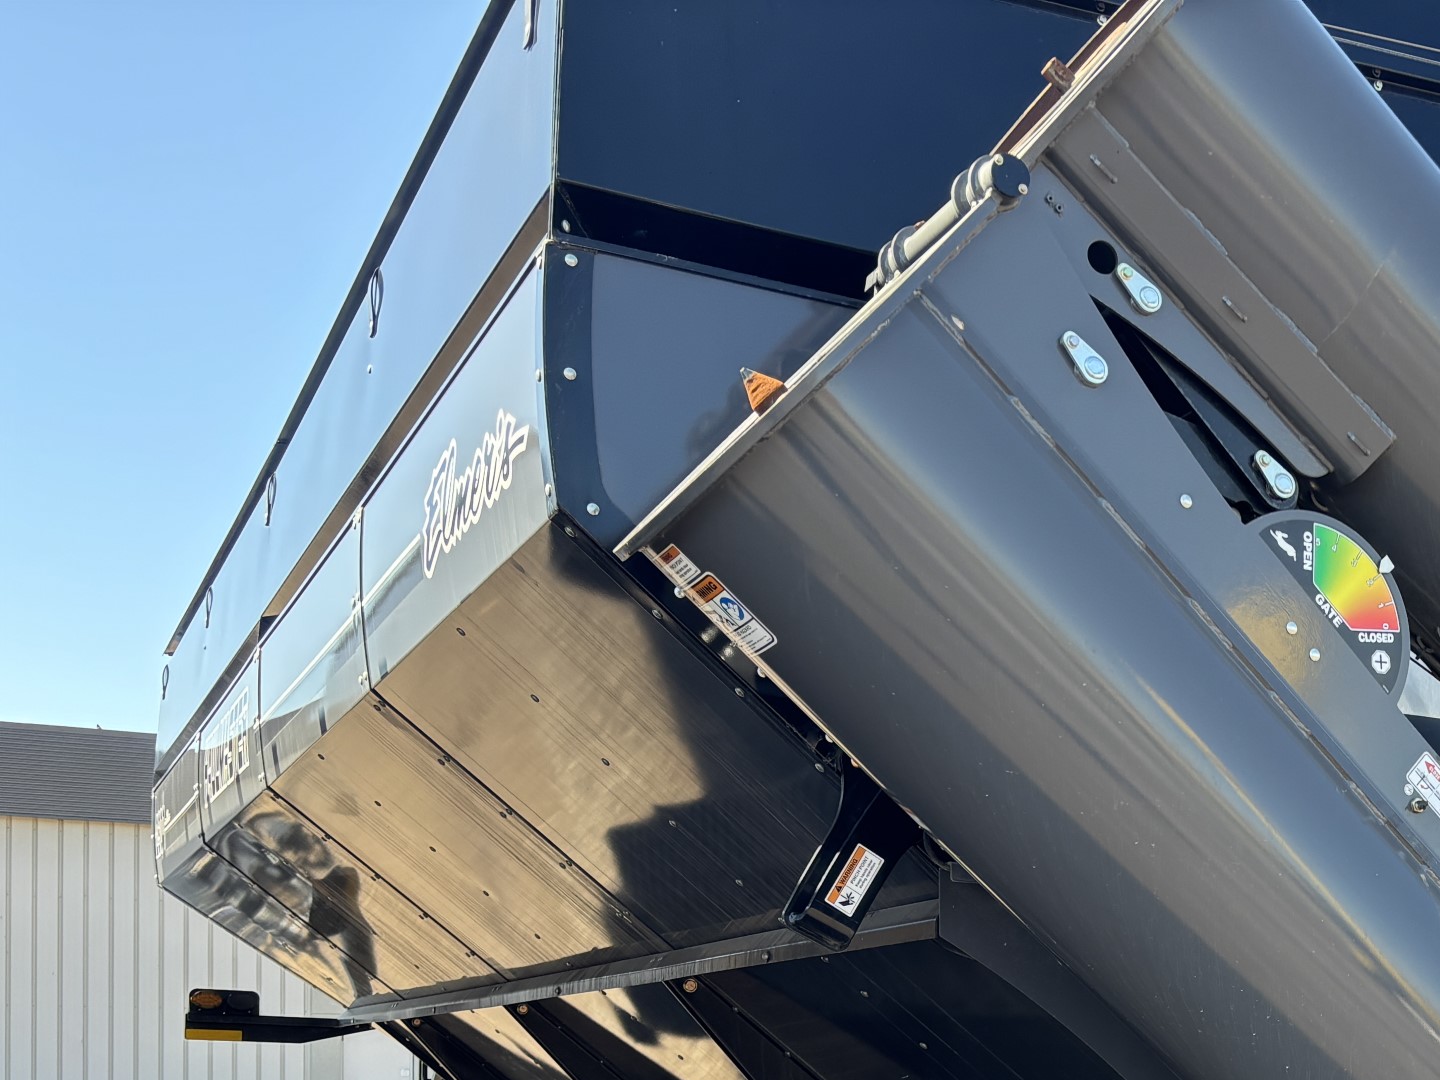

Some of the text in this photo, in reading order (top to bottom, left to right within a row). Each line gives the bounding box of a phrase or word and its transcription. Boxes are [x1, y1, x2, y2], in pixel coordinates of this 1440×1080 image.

[422, 407, 529, 579] Elmer's
[1302, 531, 1313, 571] OPEN
[1315, 593, 1343, 628] GATE
[1358, 631, 1394, 644] CLOSED
[840, 859, 858, 884] WARNING
[850, 870, 860, 884] PINCH
